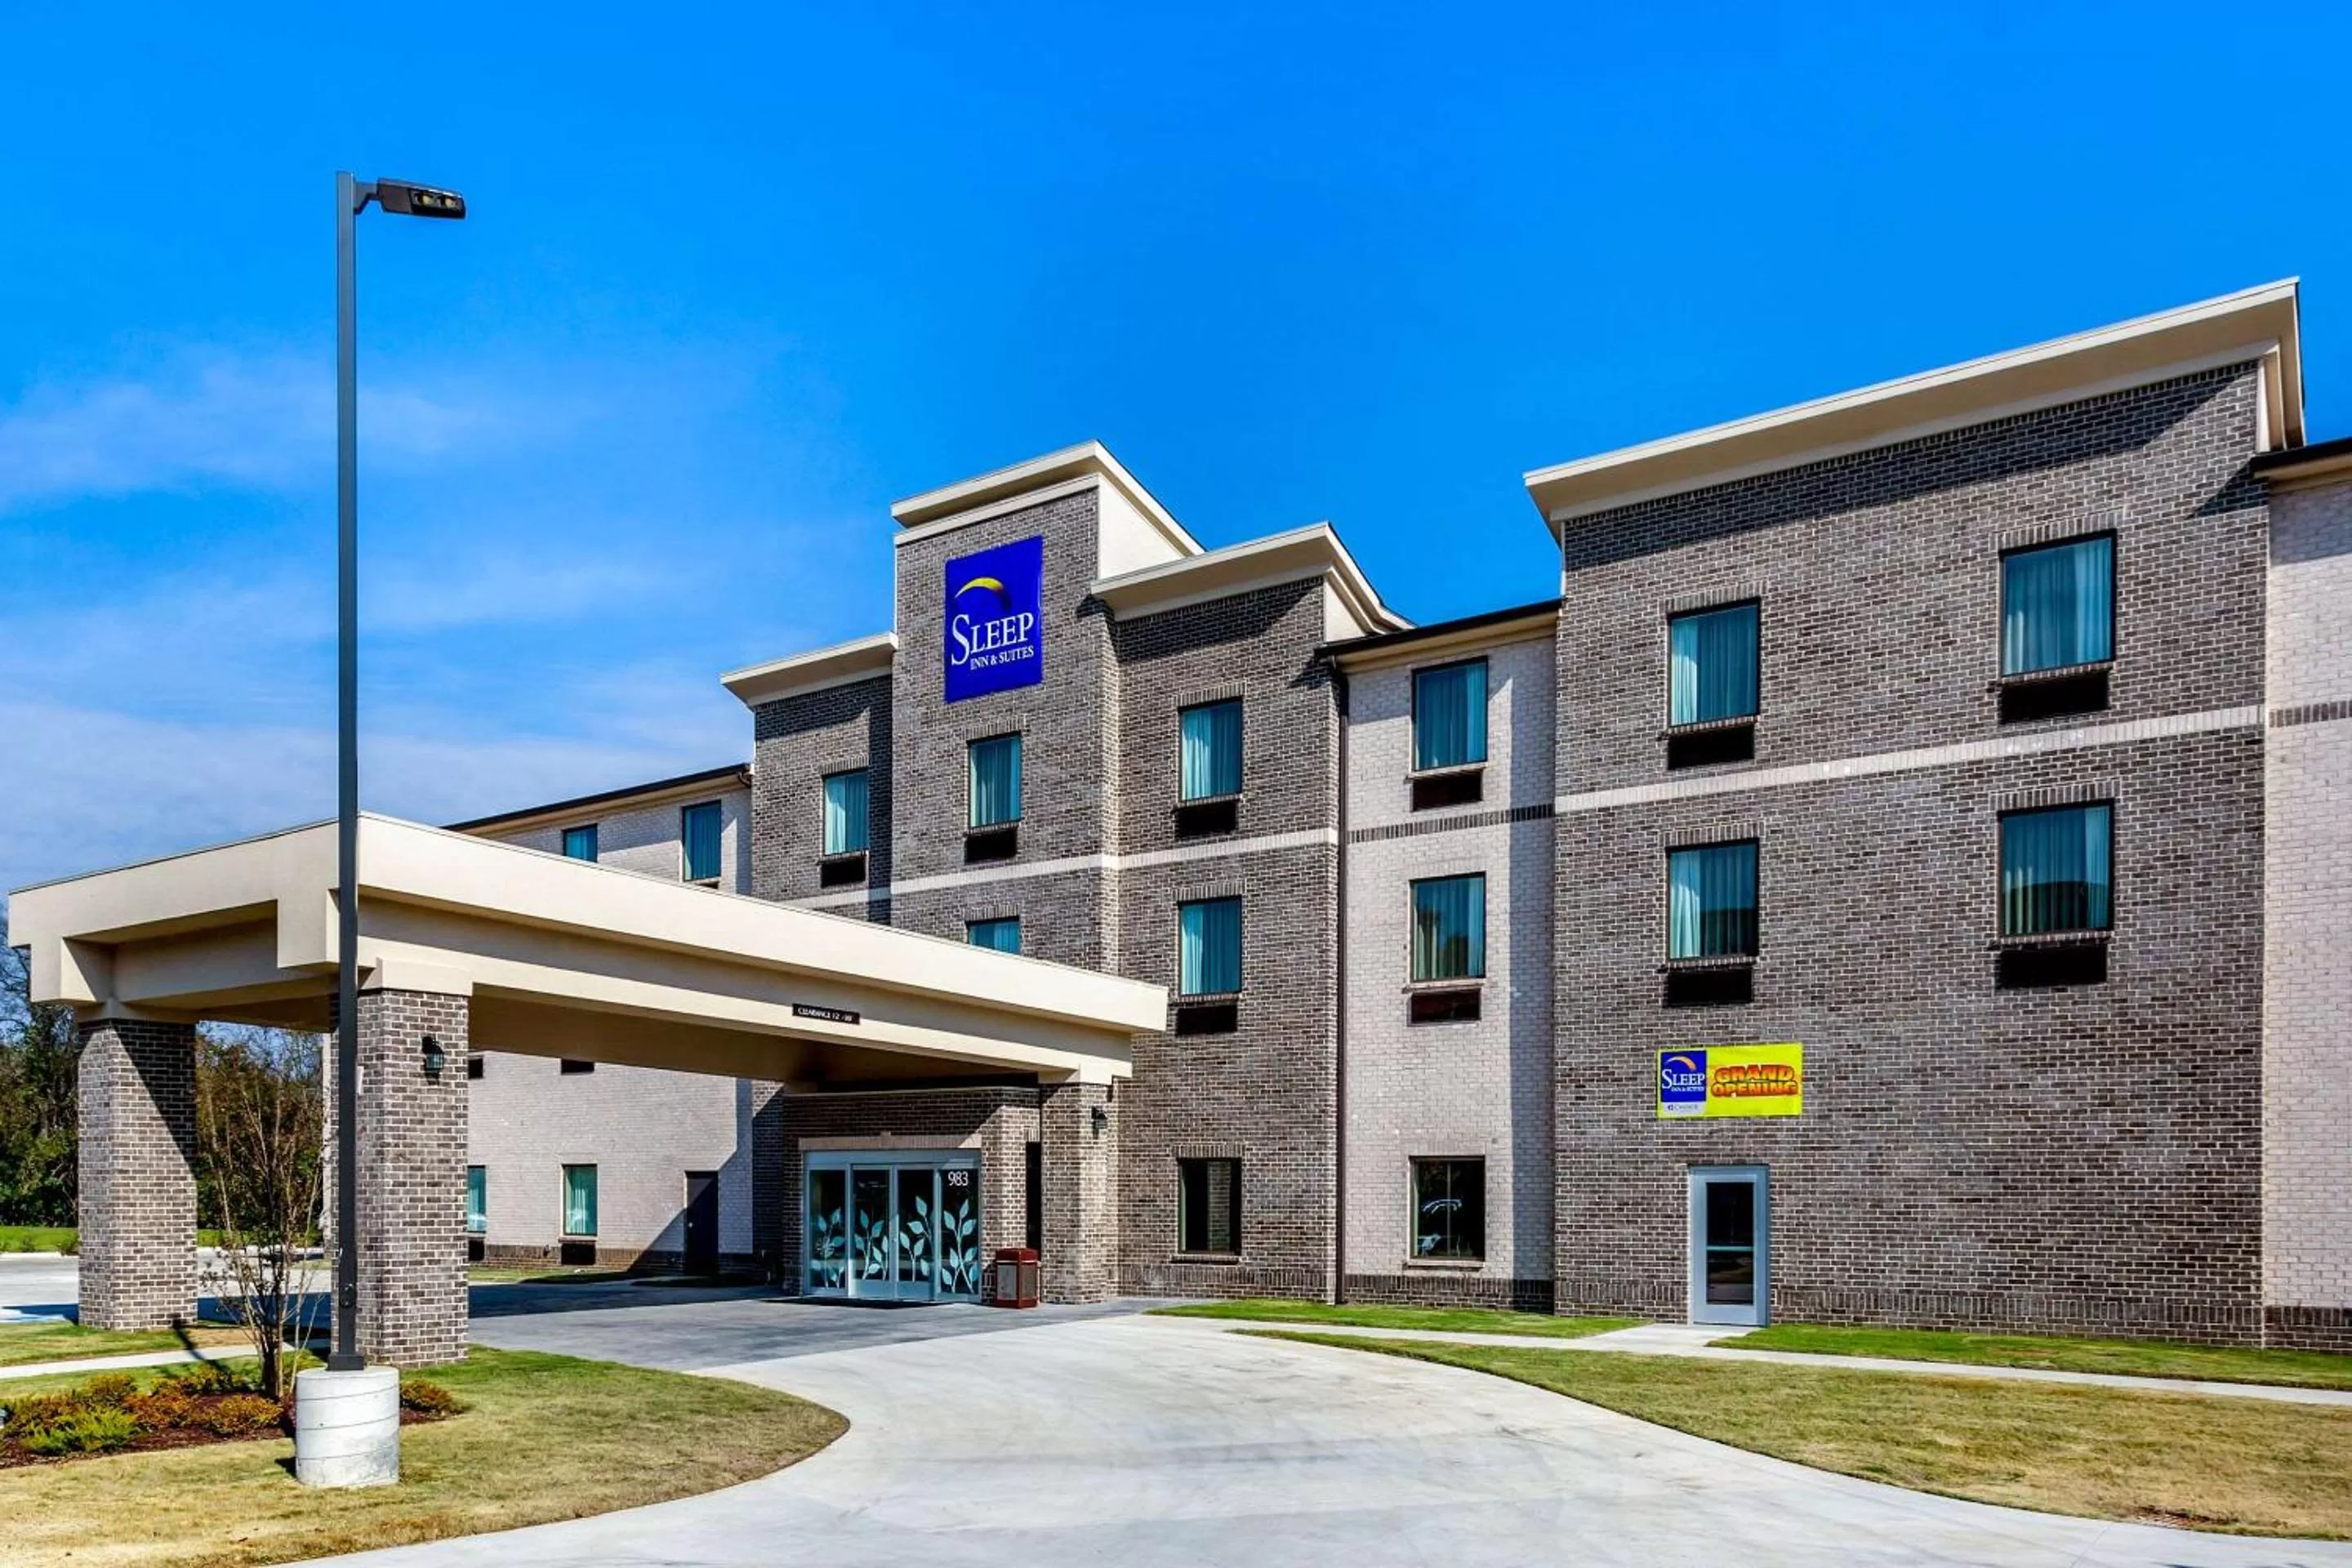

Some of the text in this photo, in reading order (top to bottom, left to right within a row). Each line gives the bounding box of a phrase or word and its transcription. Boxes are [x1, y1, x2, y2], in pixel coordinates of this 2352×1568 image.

[951, 612, 1034, 666] SLEEP
[970, 644, 1035, 670] INN & SUITES
[1661, 1068, 1705, 1089] SLEEP
[1715, 1064, 1794, 1083] GRAND
[1712, 1080, 1798, 1097] OPENING
[948, 1170, 969, 1186] 983
